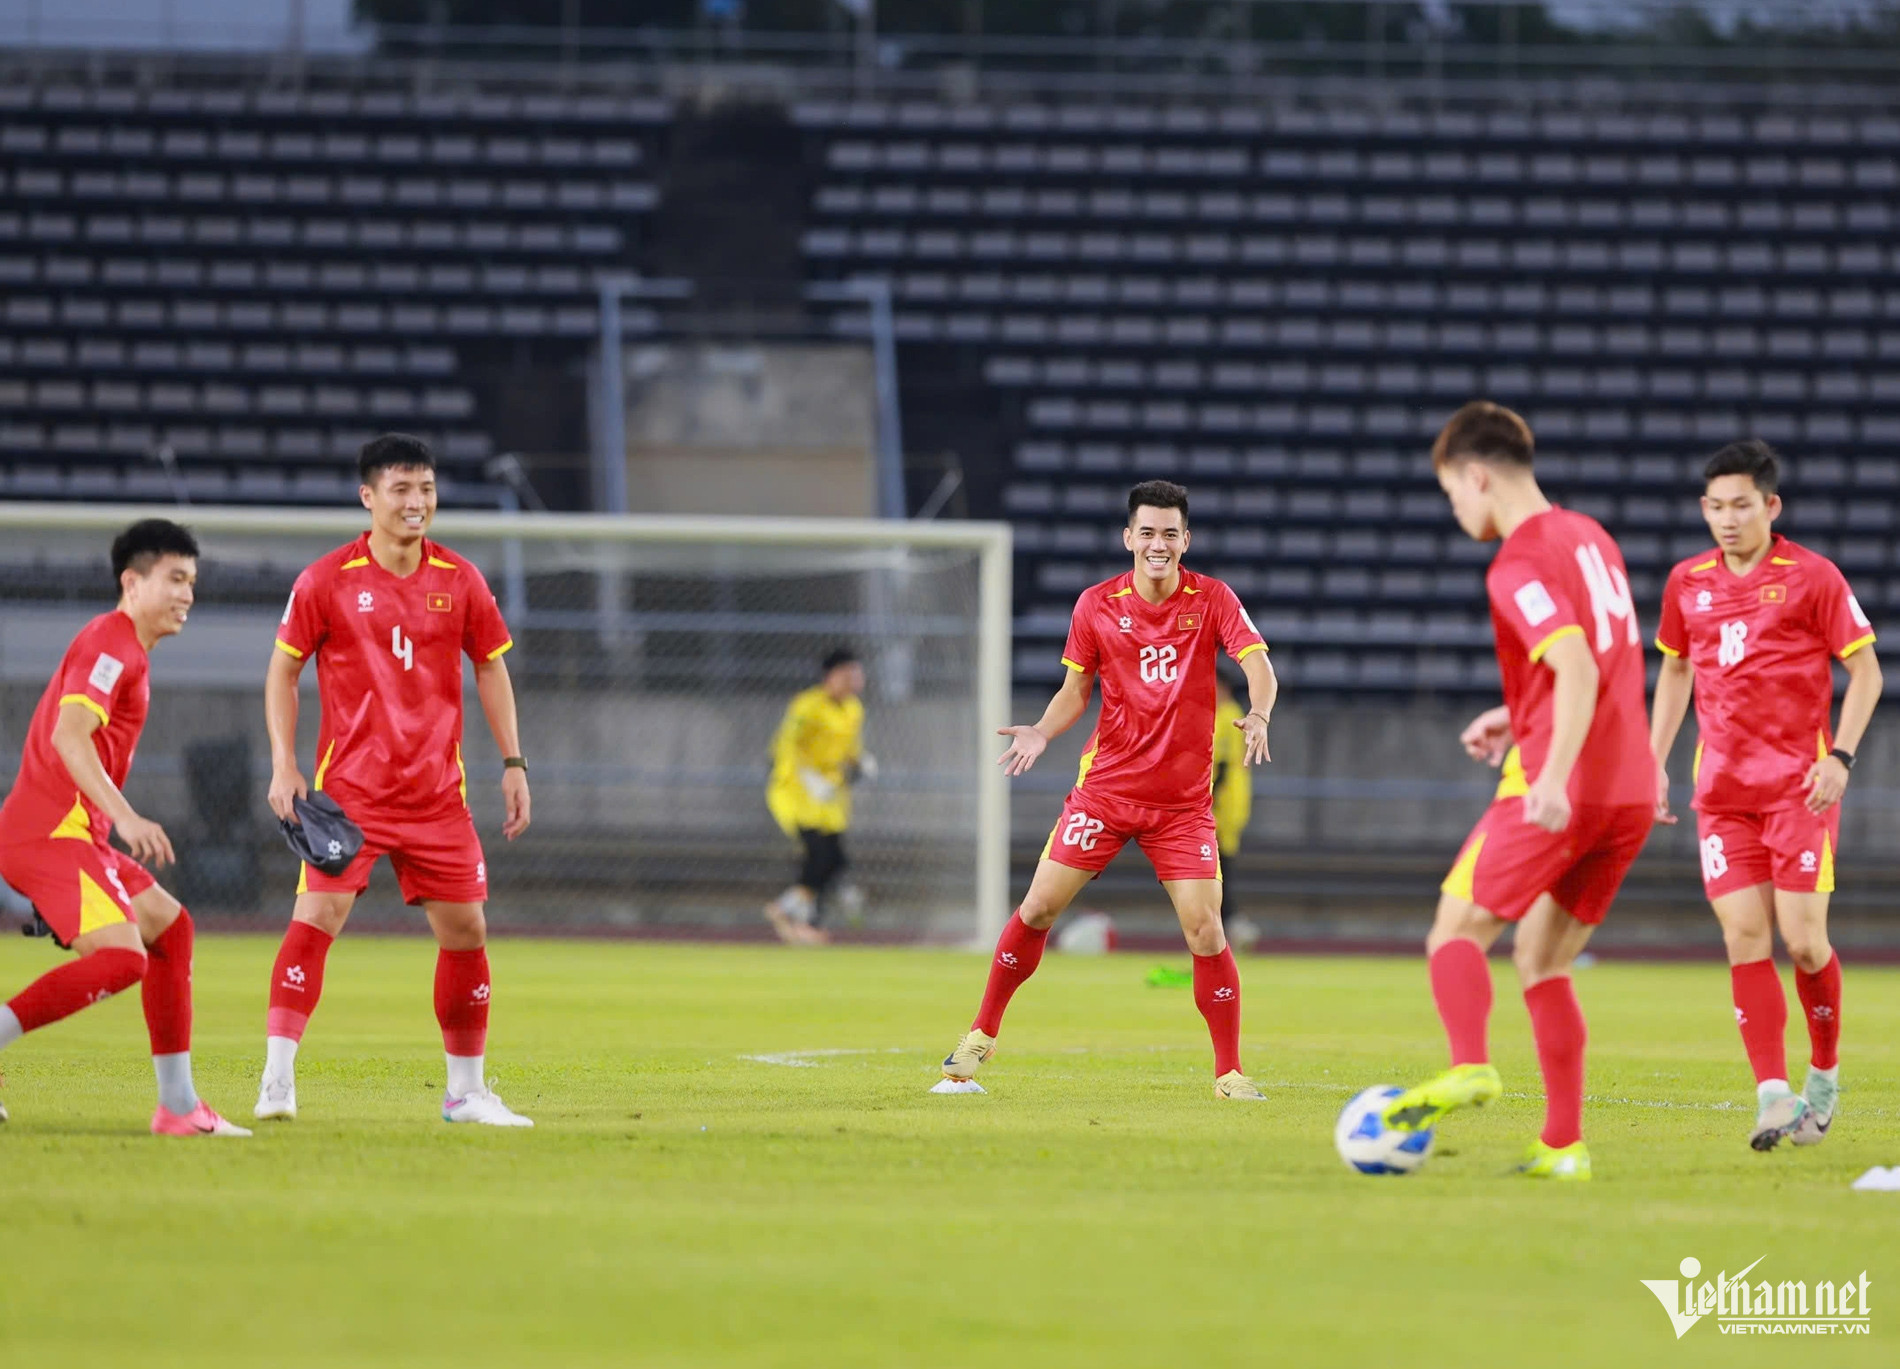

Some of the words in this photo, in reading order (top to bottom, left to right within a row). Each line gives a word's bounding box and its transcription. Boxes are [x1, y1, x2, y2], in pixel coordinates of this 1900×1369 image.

[1575, 542, 1640, 654] 14
[392, 624, 413, 672] 4
[1139, 644, 1178, 684] 22
[1718, 620, 1748, 667] 18
[1062, 812, 1104, 852] 22
[1700, 833, 1729, 882] 18
